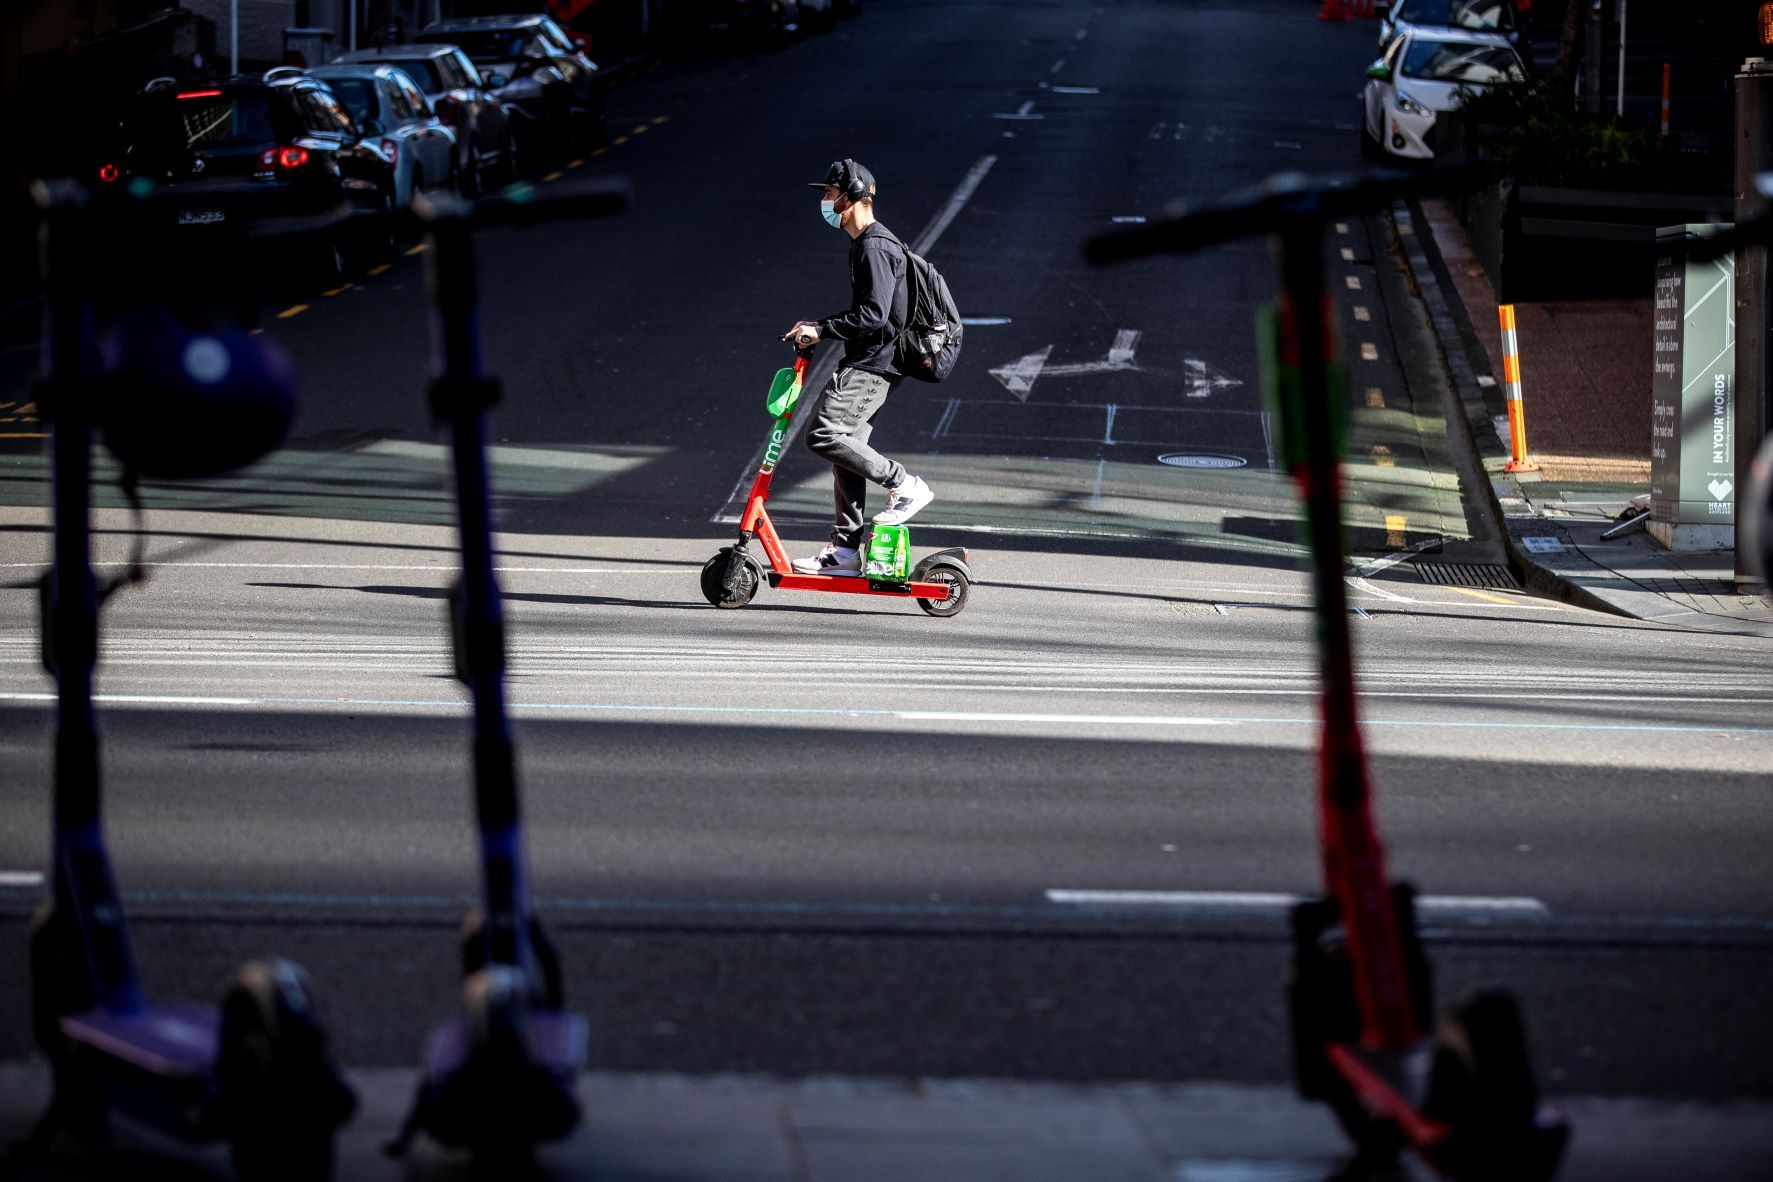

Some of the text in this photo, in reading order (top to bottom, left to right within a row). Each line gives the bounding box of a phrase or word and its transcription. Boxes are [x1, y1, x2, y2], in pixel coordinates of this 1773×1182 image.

[1713, 374, 1725, 463] IN YOUR WORDS
